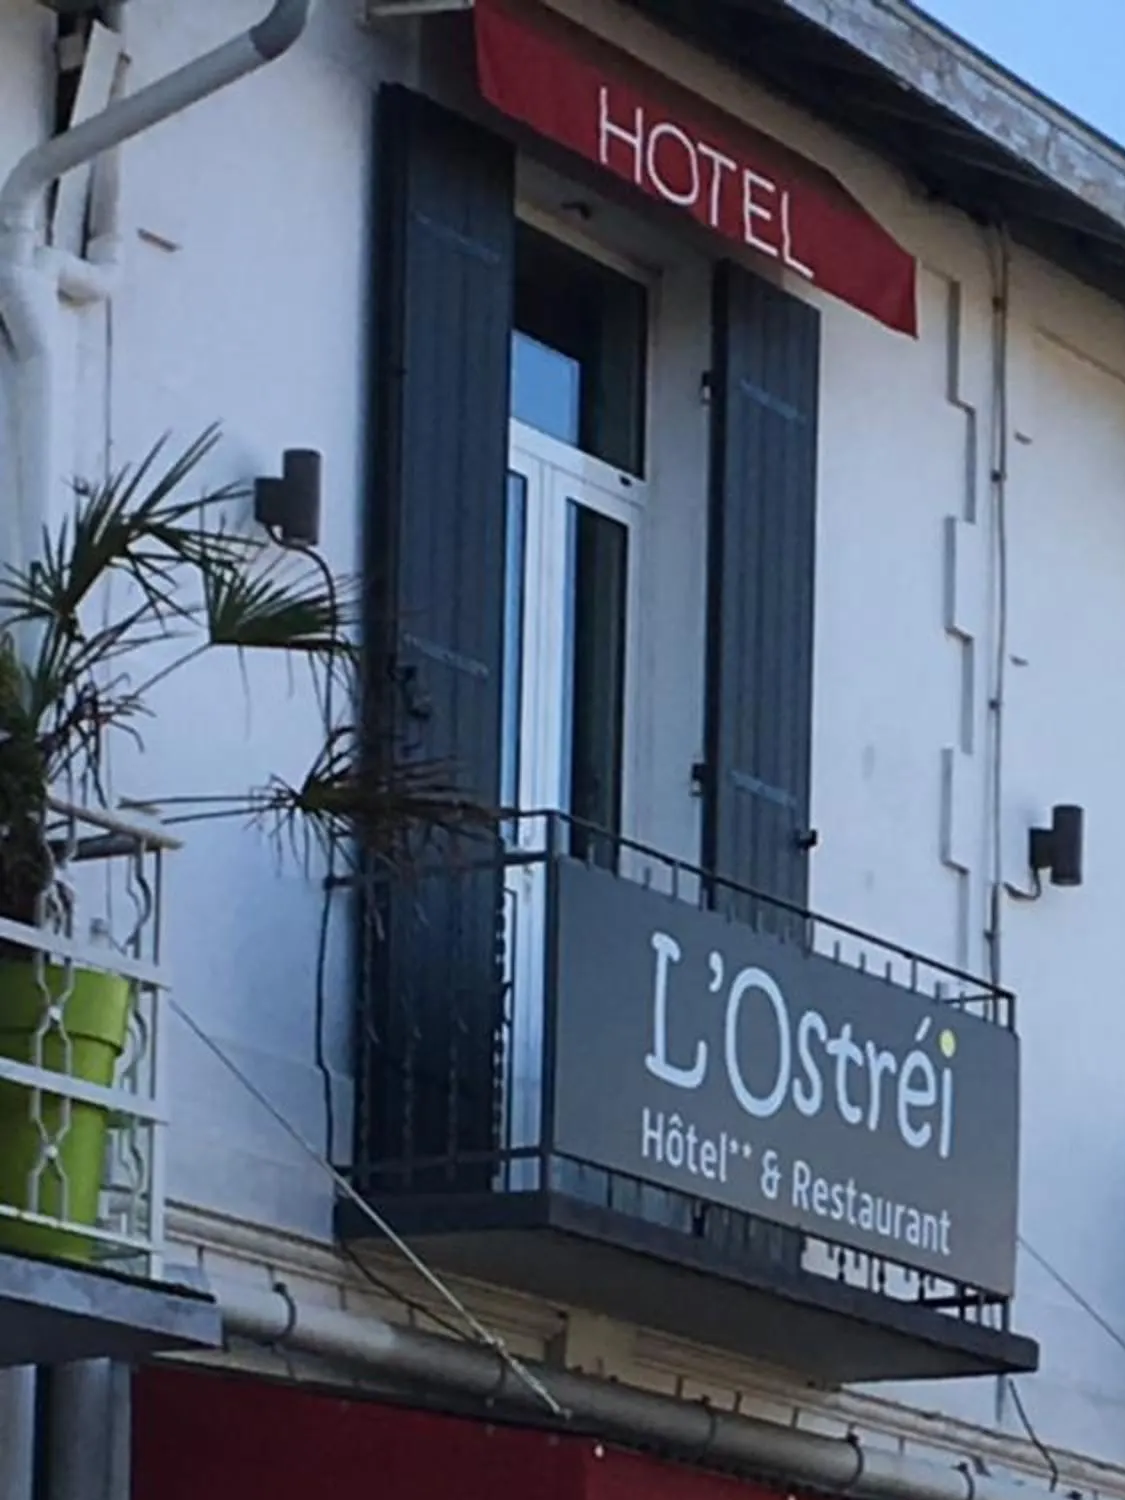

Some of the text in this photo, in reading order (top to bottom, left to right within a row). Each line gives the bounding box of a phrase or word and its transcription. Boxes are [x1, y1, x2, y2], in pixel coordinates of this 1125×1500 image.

[600, 87, 814, 278] HOTEL
[645, 932, 956, 1158] L'Ostréi
[761, 1151, 782, 1199] &
[792, 1160, 952, 1256] Restaurant
